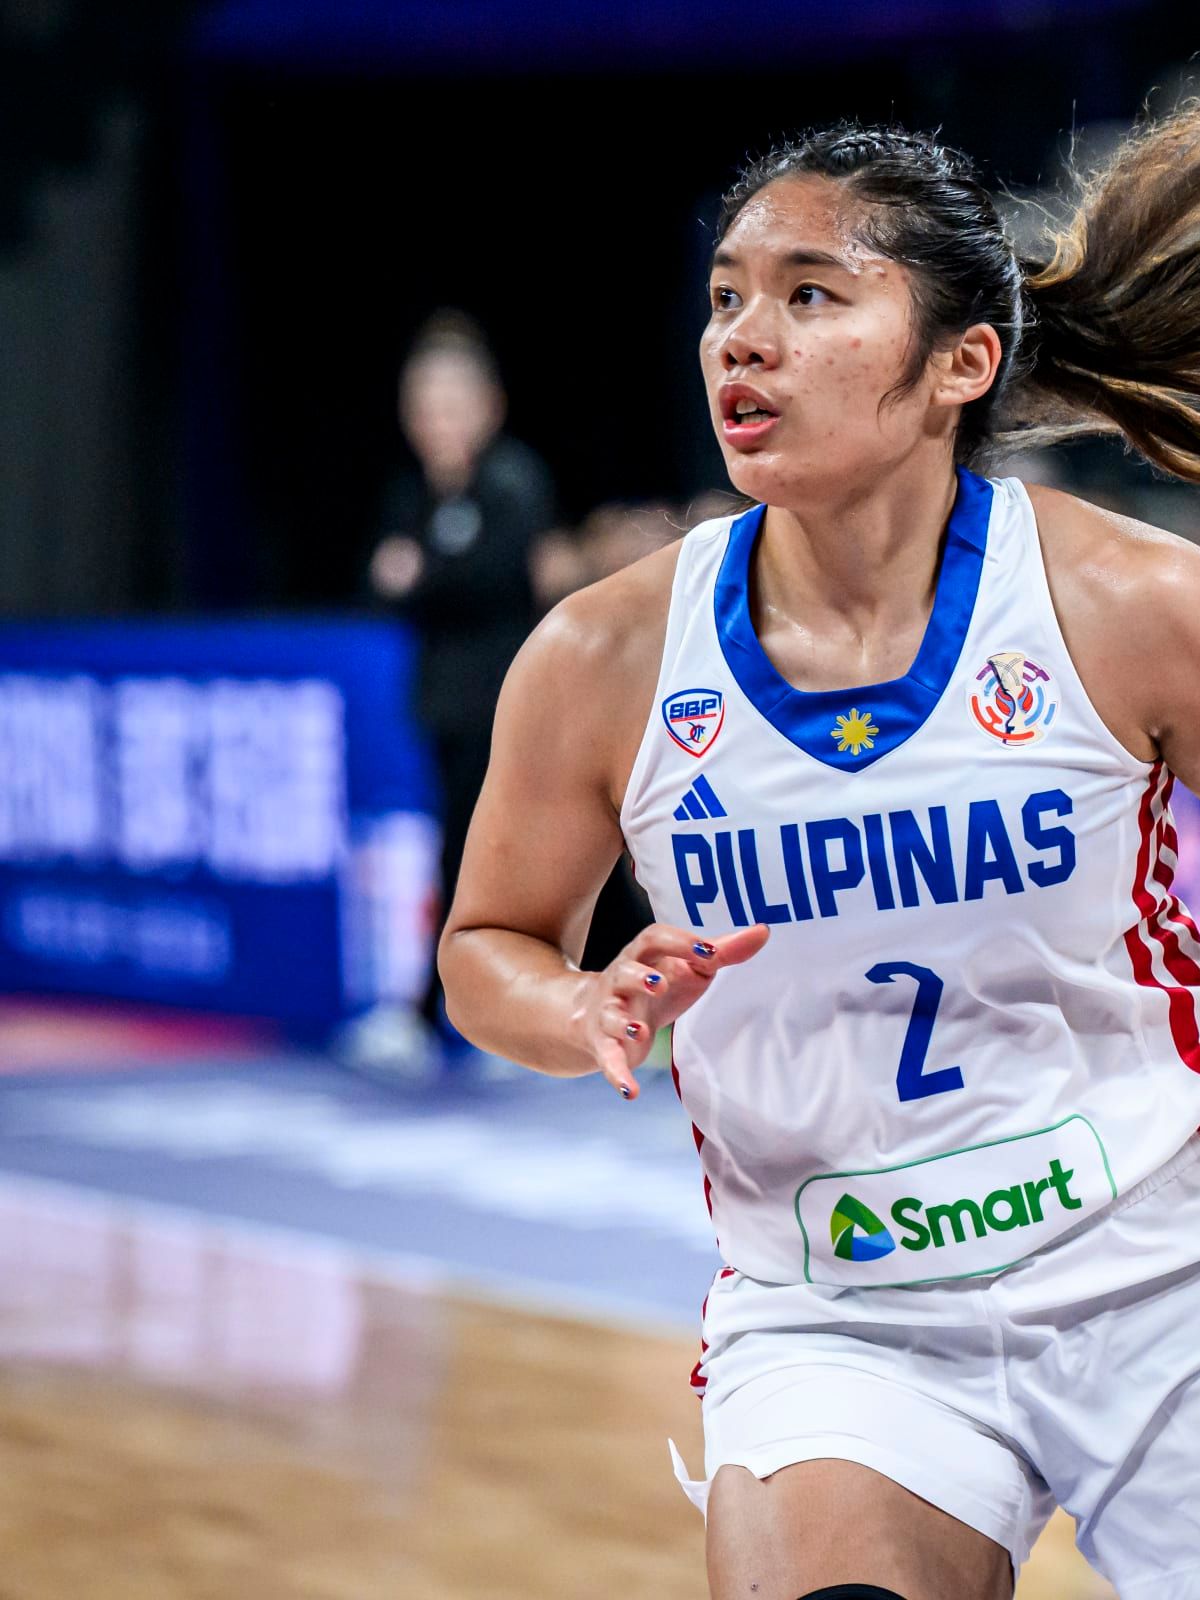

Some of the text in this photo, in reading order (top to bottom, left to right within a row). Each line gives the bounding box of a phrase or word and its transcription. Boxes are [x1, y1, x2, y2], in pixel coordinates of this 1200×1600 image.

[669, 698, 717, 720] SBP
[671, 788, 1076, 928] PILIPINAS
[864, 960, 965, 1103] 2
[890, 1158, 1083, 1251] Smart
